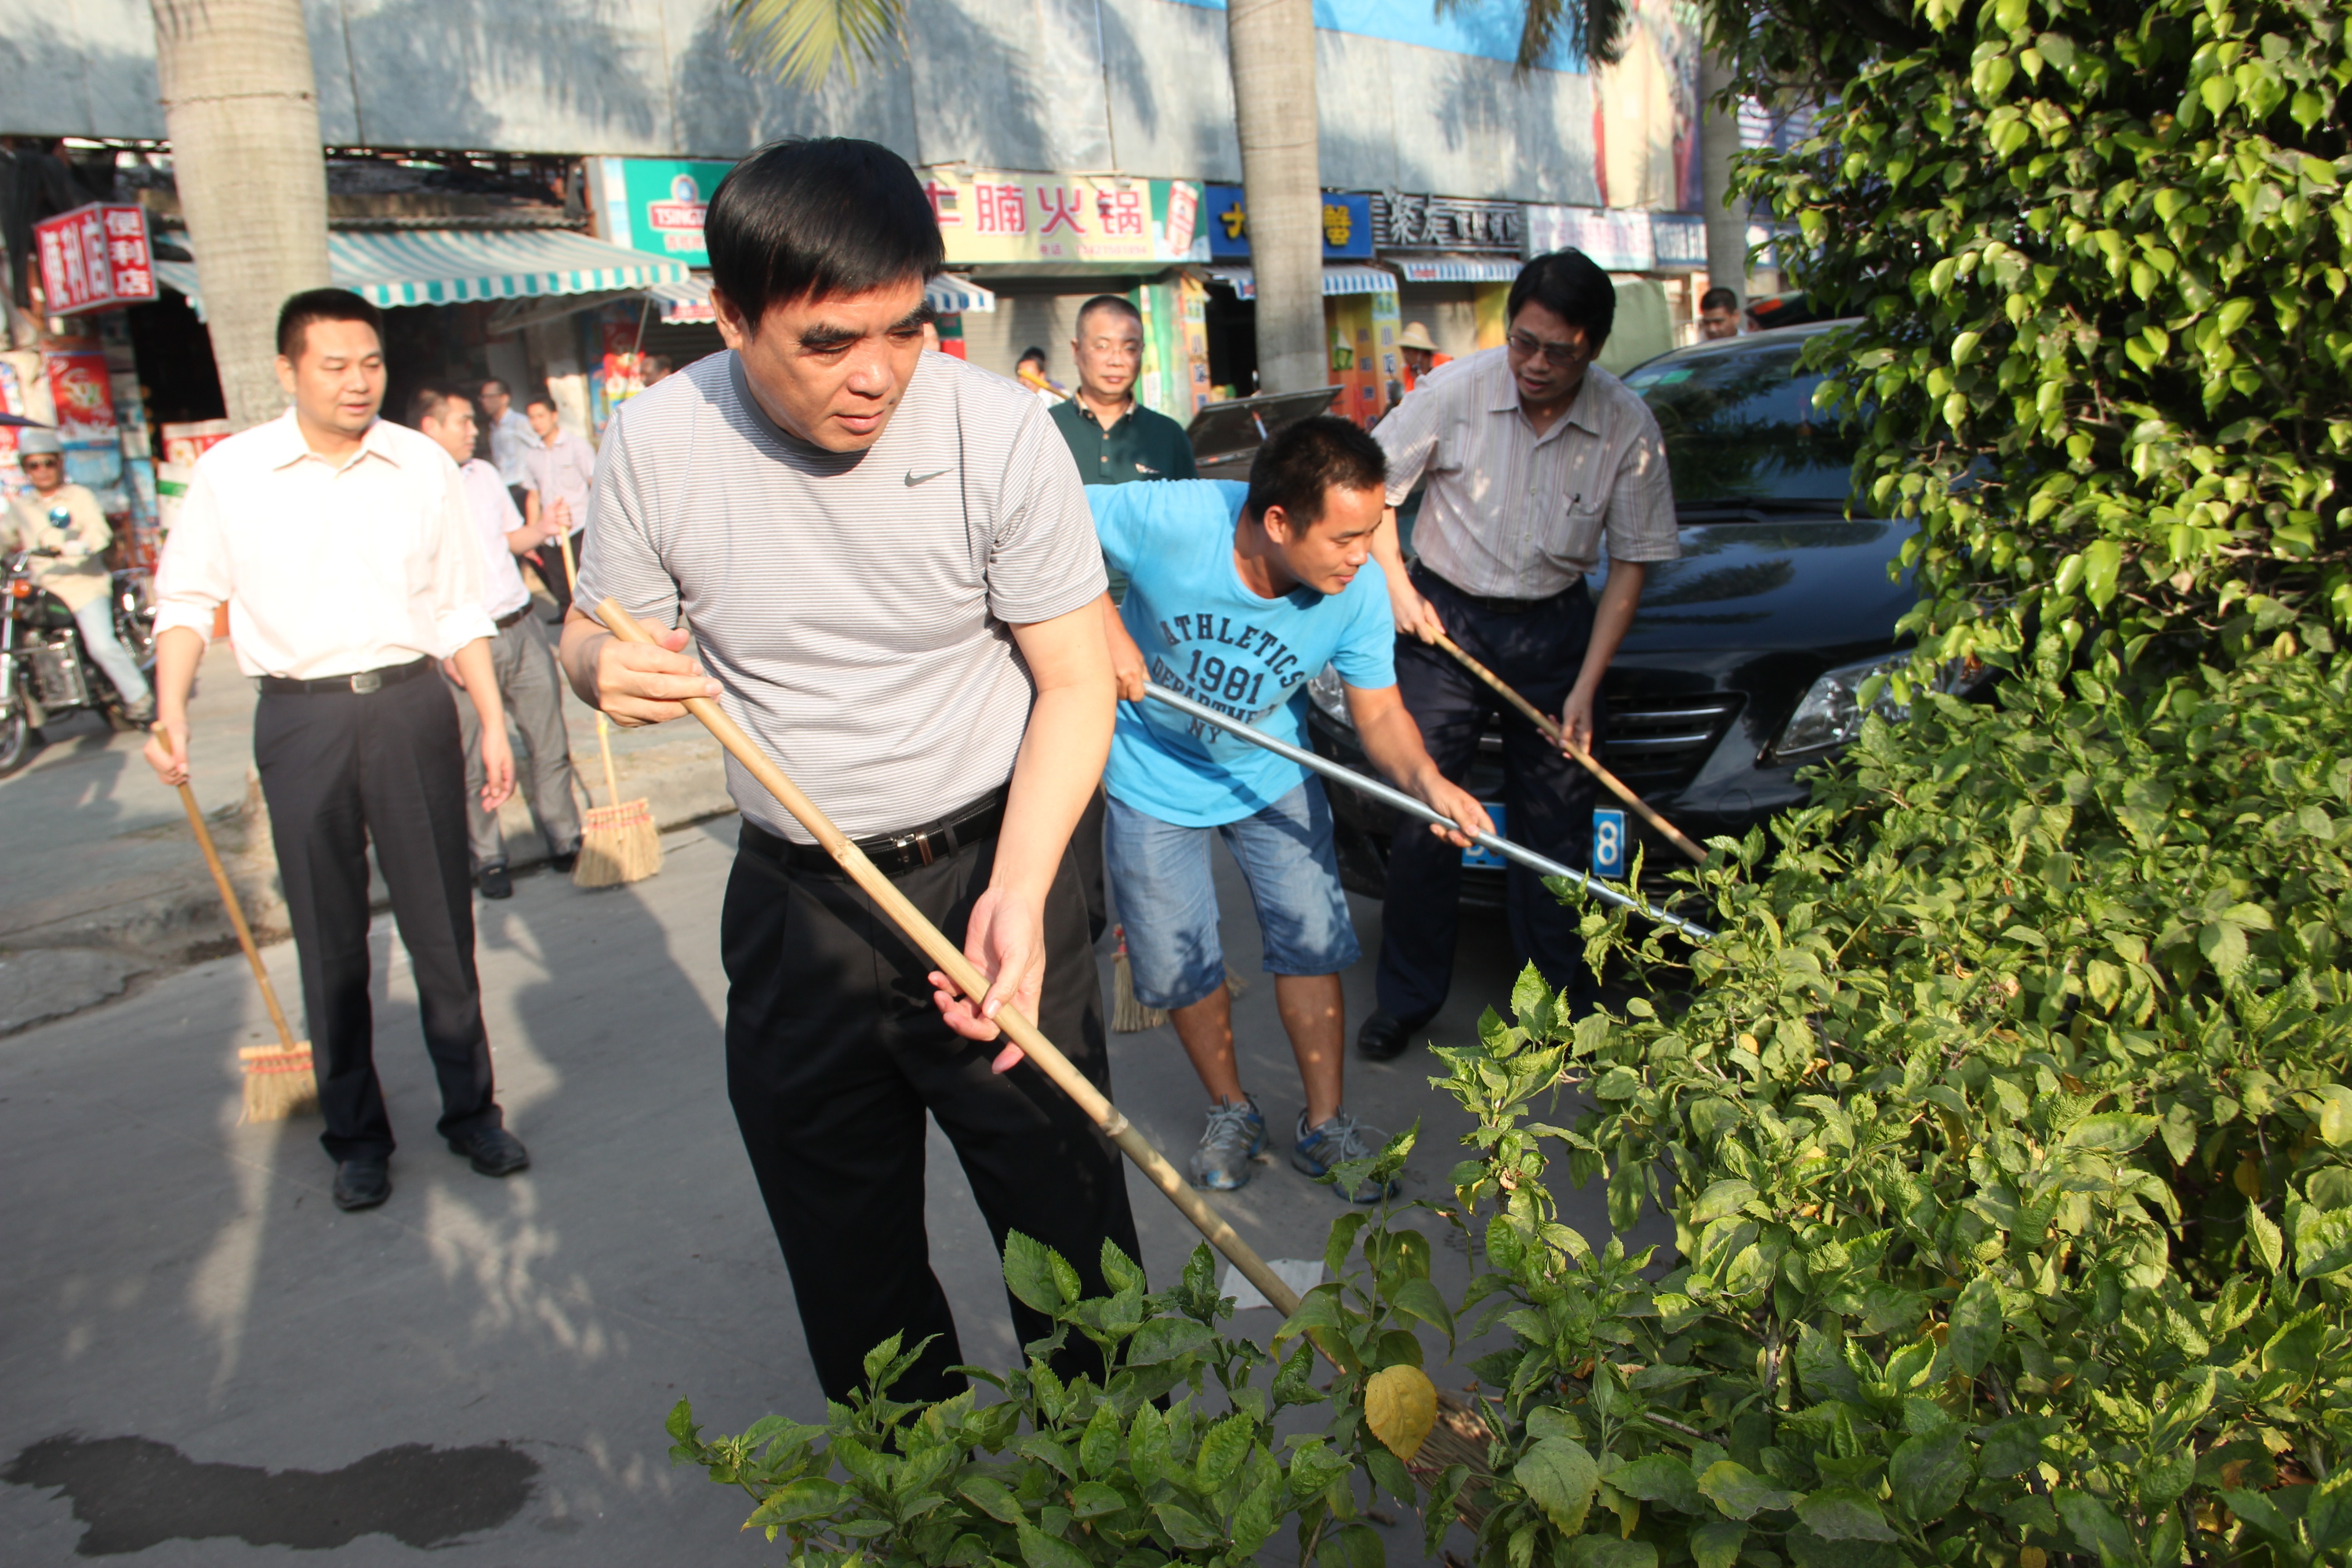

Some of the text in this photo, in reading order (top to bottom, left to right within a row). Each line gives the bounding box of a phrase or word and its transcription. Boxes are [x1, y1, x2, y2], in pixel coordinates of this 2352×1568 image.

[1160, 613, 1305, 688] ATHLETICS
[1187, 649, 1264, 705] 1981
[1187, 718, 1224, 744] NY
